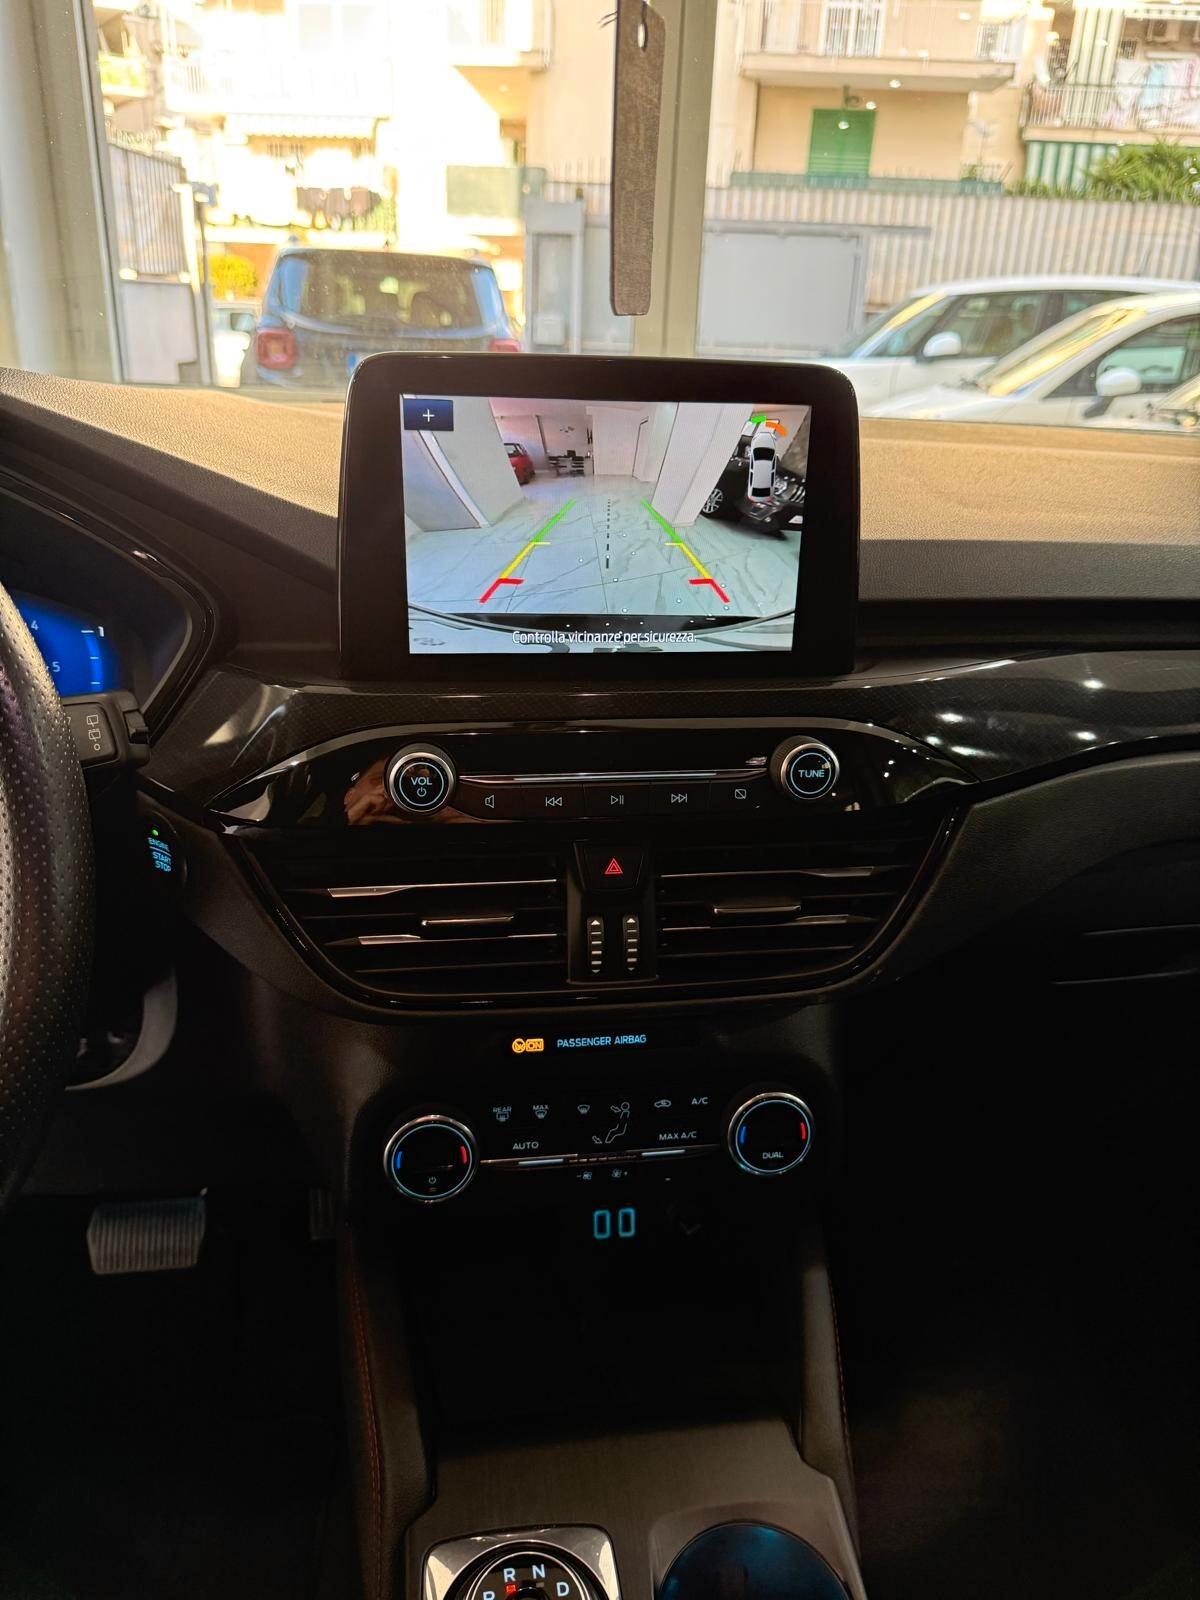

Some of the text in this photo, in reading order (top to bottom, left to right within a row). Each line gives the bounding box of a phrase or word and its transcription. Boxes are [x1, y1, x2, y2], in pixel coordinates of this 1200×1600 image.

[31, 620, 39, 630] 4
[512, 630, 697, 645] Controlla vicinanze per sicurezza.
[52, 661, 61, 672] 5
[798, 769, 825, 778] TUNE
[410, 776, 433, 786] VOL
[152, 851, 172, 865] START
[155, 860, 172, 872] STOP
[528, 1041, 542, 1050] ON
[557, 1034, 647, 1048] PASSENGER AIRBAG
[691, 1096, 709, 1105] A/C
[659, 1130, 697, 1141] MAX A/C
[512, 1141, 540, 1150] AUTO
[762, 1151, 784, 1160] DUAL
[503, 1568, 516, 1582] R
[532, 1564, 545, 1579] N
[556, 1582, 569, 1597] D
